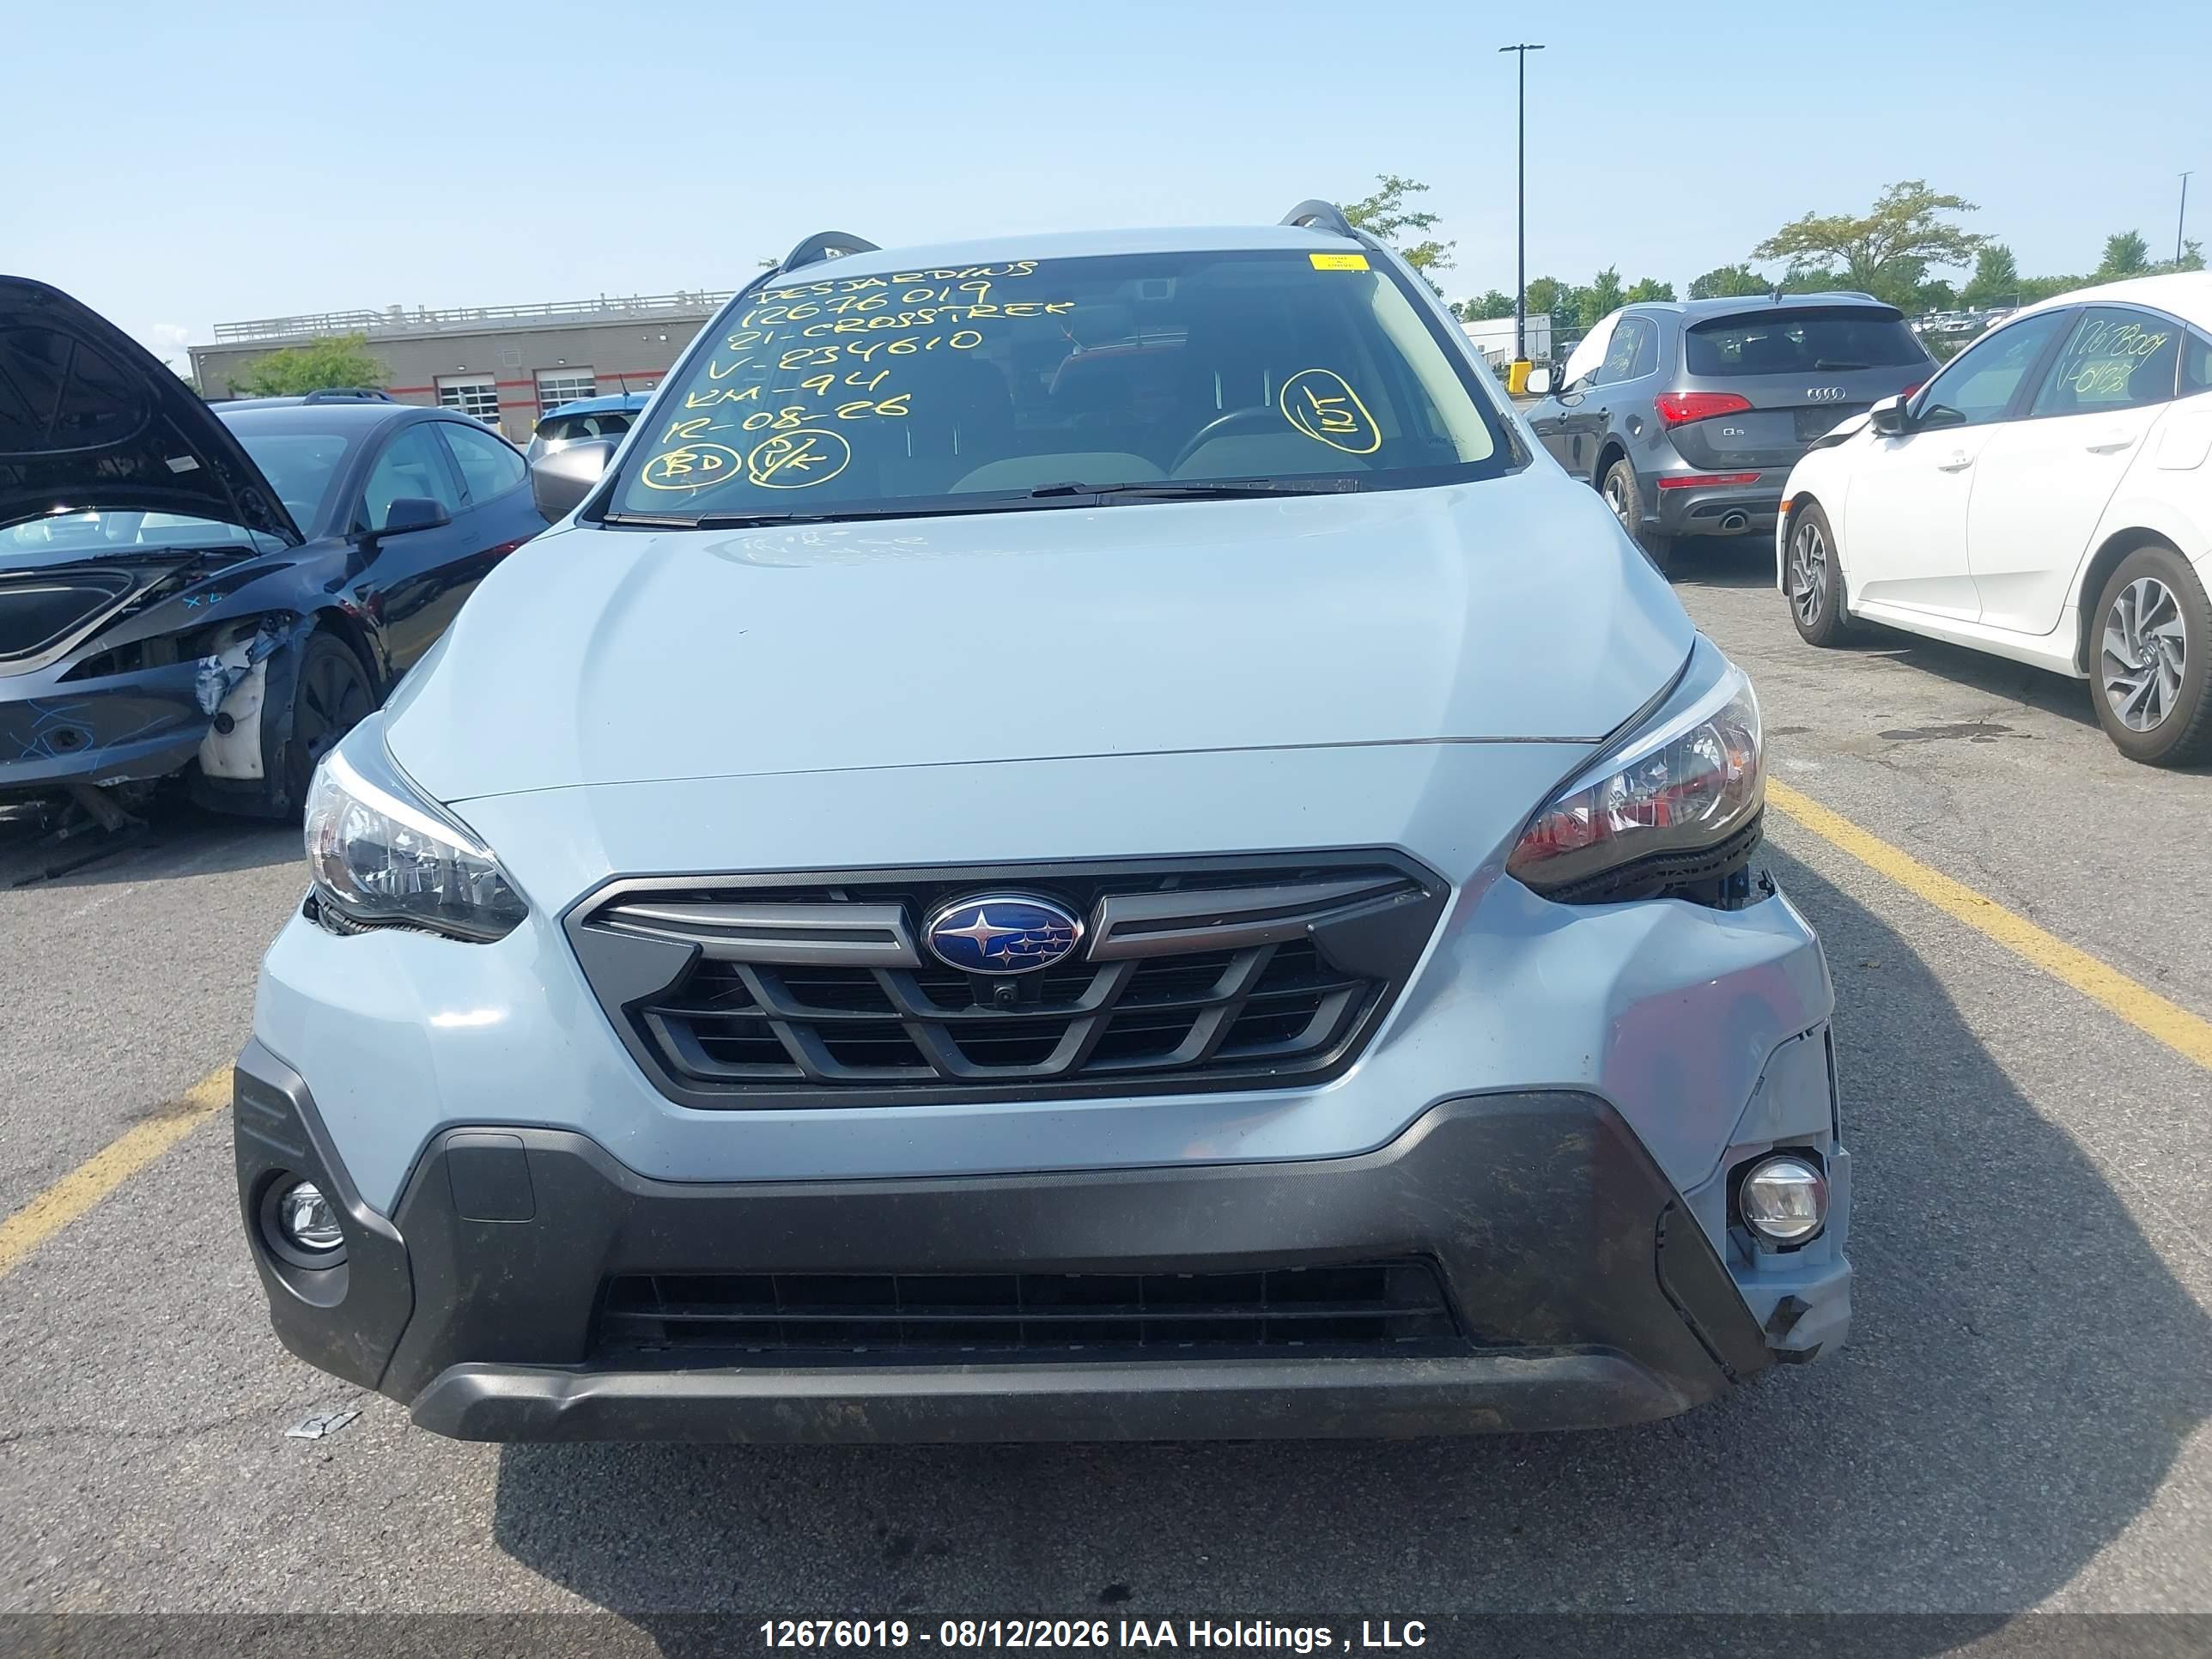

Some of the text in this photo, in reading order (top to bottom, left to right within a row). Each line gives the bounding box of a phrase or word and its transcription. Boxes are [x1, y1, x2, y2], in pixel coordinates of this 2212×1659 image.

[749, 261, 1039, 304] DESJARDINS
[709, 331, 982, 379] V-234610
[1723, 428, 1745, 436] Q5
